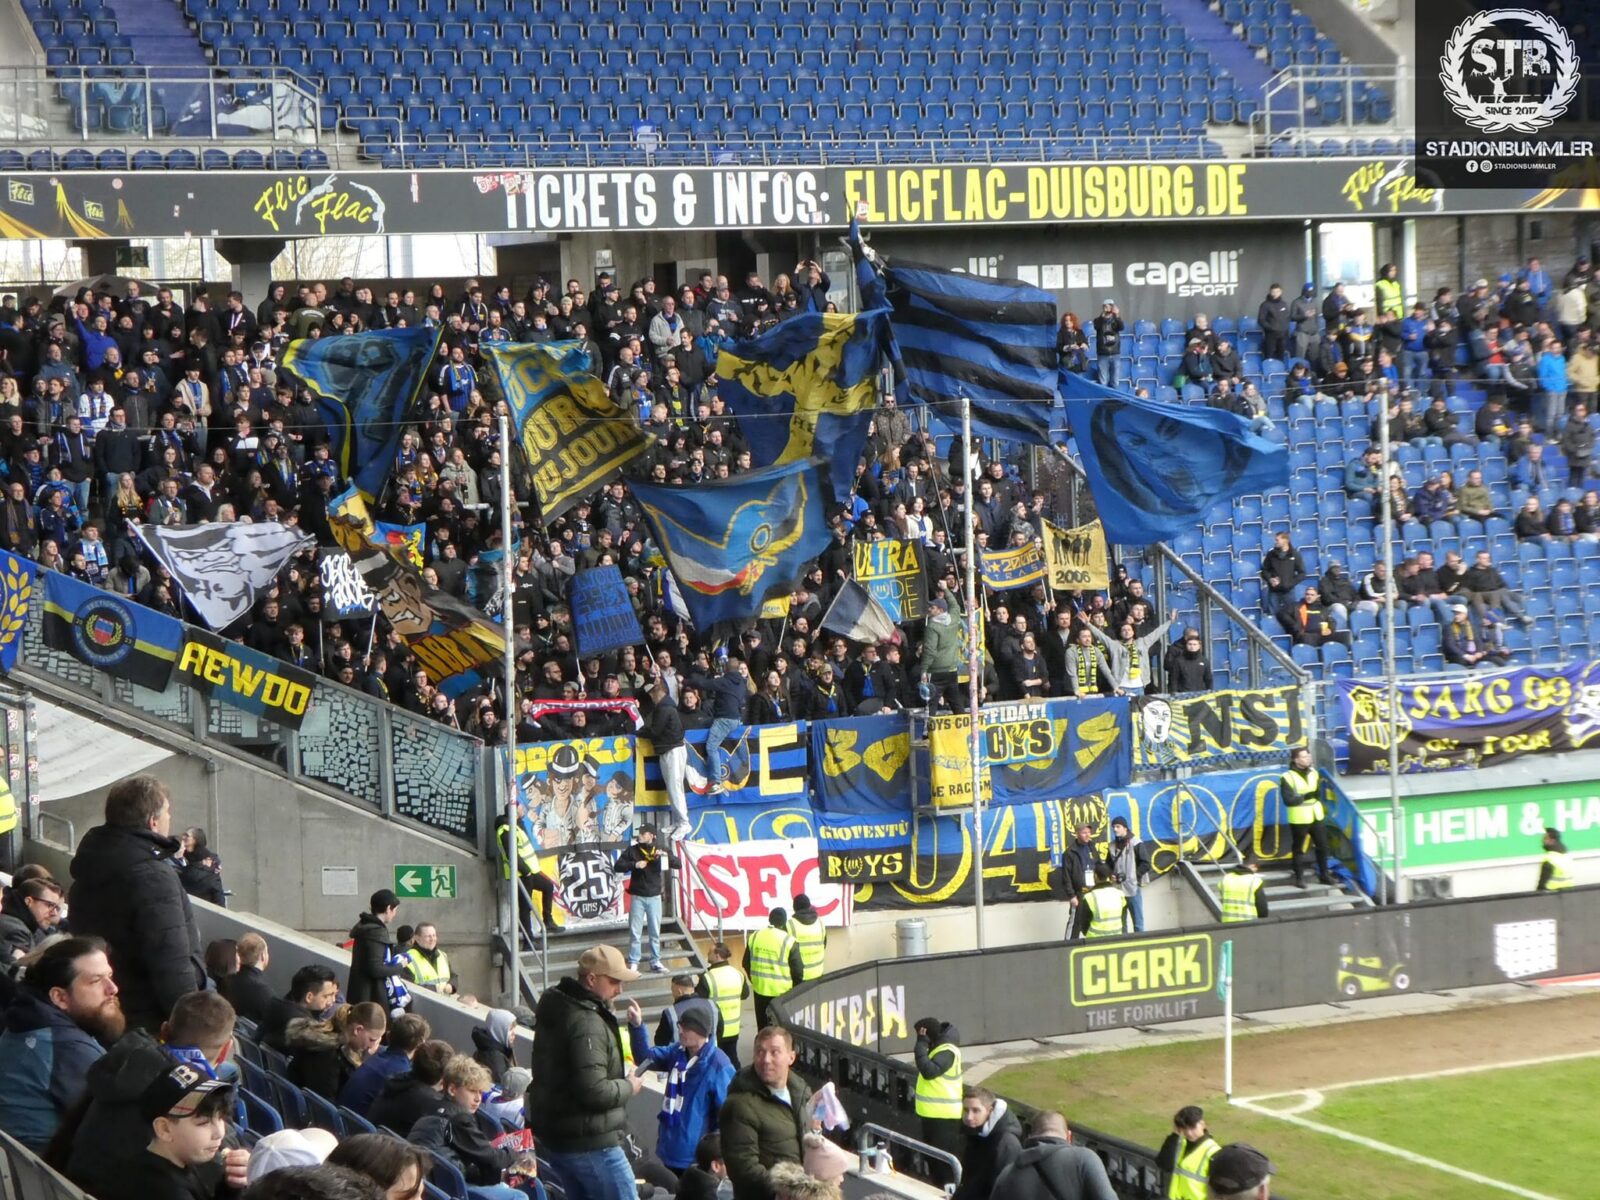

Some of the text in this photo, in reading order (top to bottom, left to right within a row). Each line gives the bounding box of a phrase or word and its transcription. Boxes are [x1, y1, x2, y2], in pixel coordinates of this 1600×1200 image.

[254, 175, 373, 234] Flic Flac
[503, 172, 657, 229] TICKETS
[673, 172, 696, 227] &
[713, 171, 830, 226] INFOS:
[845, 164, 1248, 223] FLICFLAC-DUISBURG.DE
[1342, 161, 1384, 211] Flic
[1126, 250, 1239, 294] capelli
[1178, 284, 1238, 297] SPORT
[855, 540, 918, 577] ULTRA
[1055, 569, 1092, 585] 2006
[1410, 677, 1514, 722] SARG
[1413, 804, 1509, 845] HEIM
[1519, 801, 1545, 835] &
[567, 860, 609, 902] 25
[693, 853, 841, 919] SFC
[1082, 944, 1201, 996] CLARK
[1086, 1000, 1198, 1027] THE FORKLIFT
